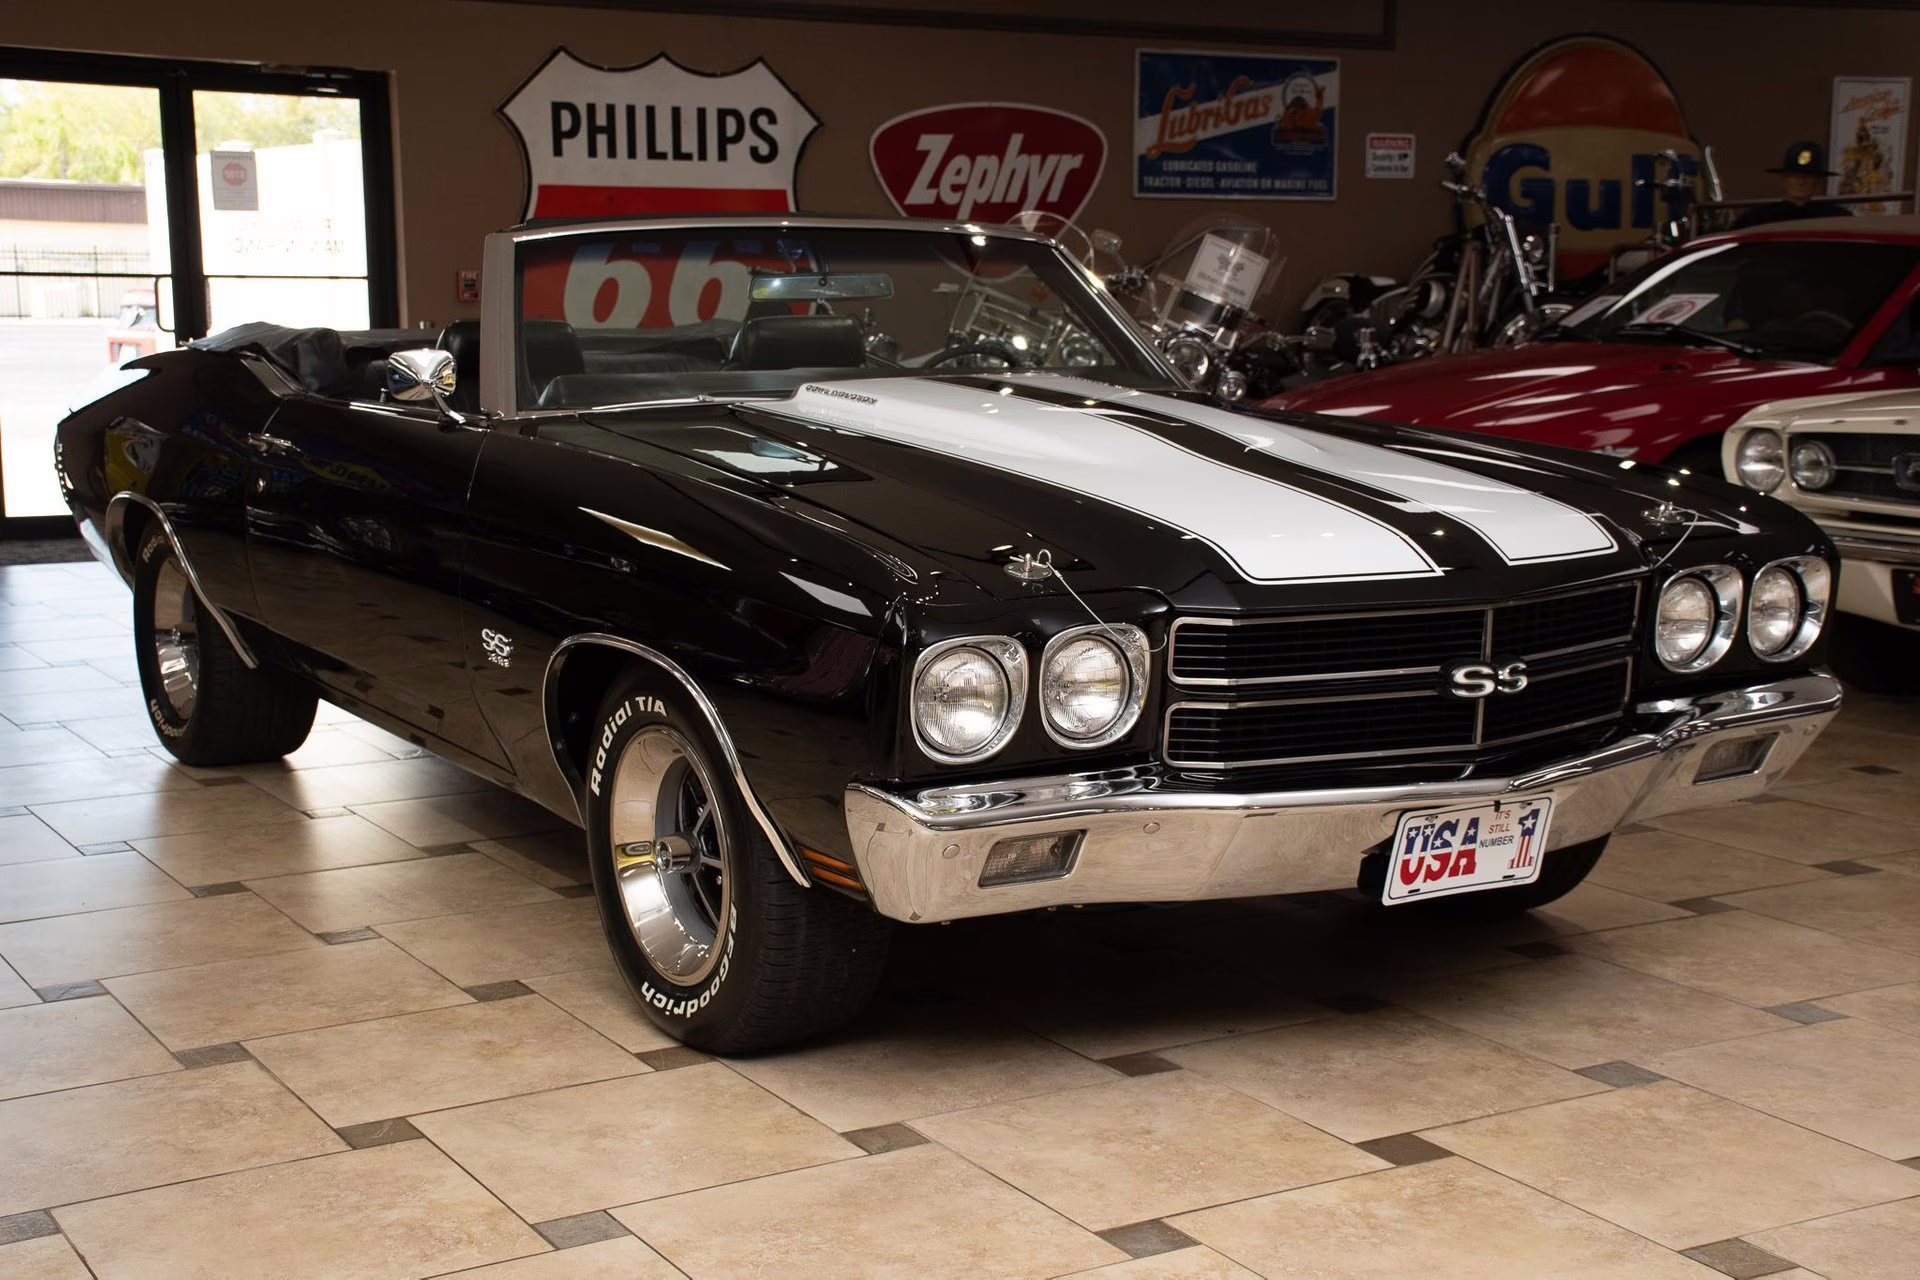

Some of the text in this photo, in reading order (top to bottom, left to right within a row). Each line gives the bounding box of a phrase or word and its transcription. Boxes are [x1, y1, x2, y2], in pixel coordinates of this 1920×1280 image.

[550, 101, 779, 165] PHILLIPS
[904, 132, 1087, 232] Zephyr
[1215, 160, 1258, 174] GASOLINE
[1483, 143, 1701, 231] Gulf
[563, 241, 751, 330] 66
[1452, 662, 1528, 698] SS
[590, 700, 633, 797] Radial
[1478, 834, 1514, 849] NUMBER
[1488, 821, 1511, 834] STILL
[1494, 809, 1512, 821] IT'S
[1509, 808, 1541, 869] 1
[1400, 816, 1480, 886] USA
